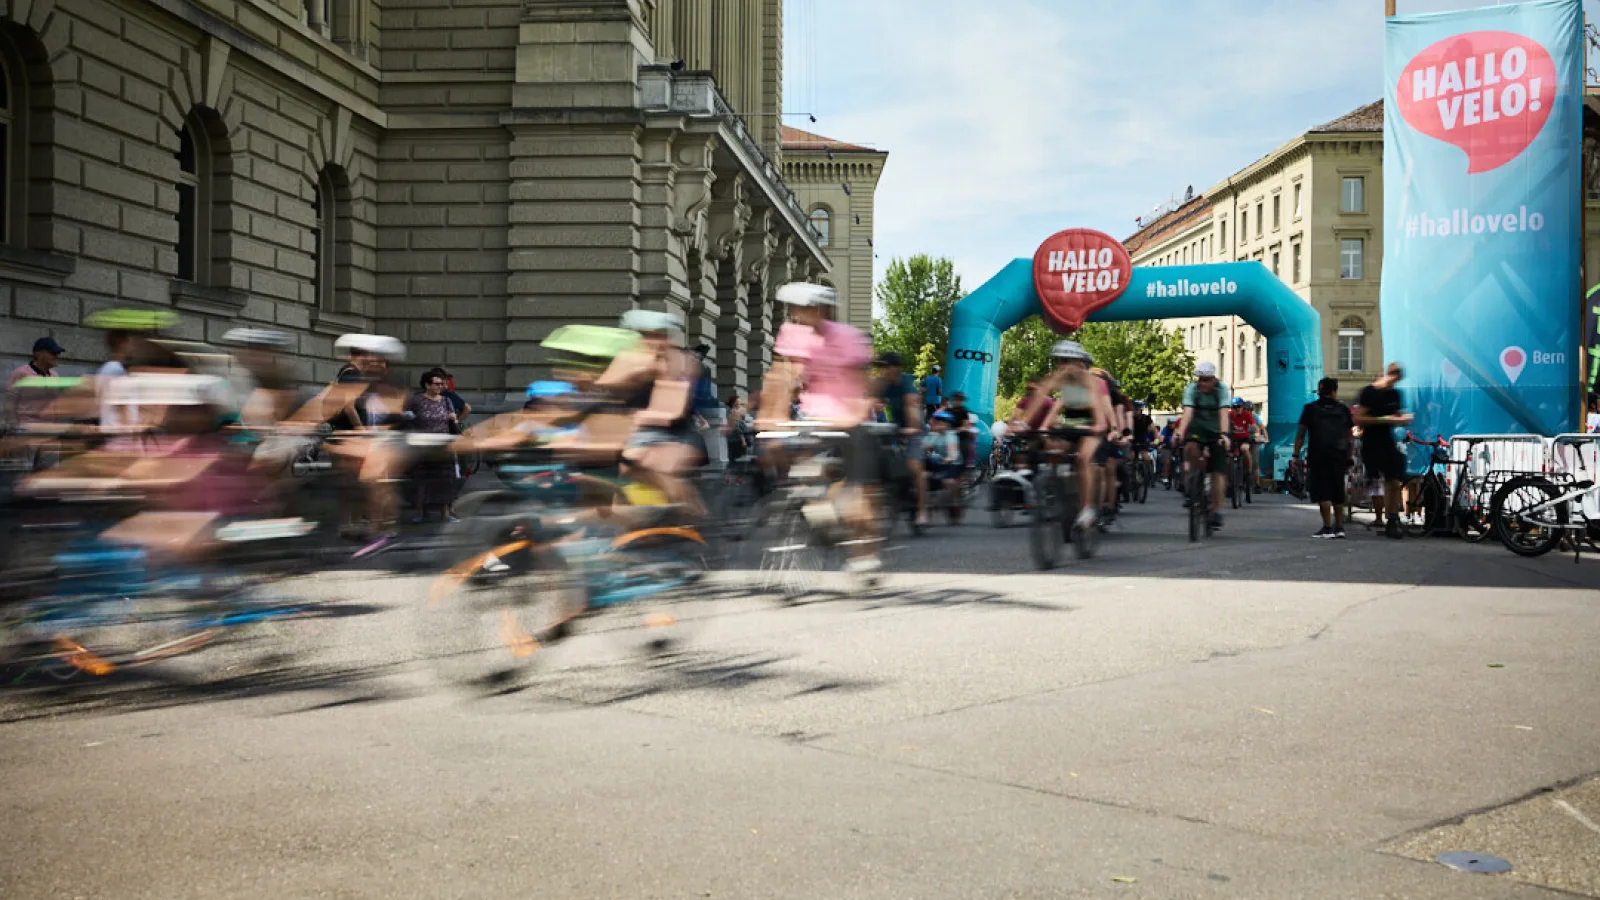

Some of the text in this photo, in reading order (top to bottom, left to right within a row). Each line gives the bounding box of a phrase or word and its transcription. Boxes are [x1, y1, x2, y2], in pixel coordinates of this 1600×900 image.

[1412, 46, 1527, 102] HALLO
[1436, 77, 1542, 130] VELO!
[1405, 205, 1544, 238] #hallovelo
[1048, 247, 1113, 272] HALLO
[1061, 268, 1120, 294] VELO!
[1146, 277, 1237, 298] #hallovelo
[954, 348, 993, 365] coop
[1532, 350, 1565, 364] Bern
